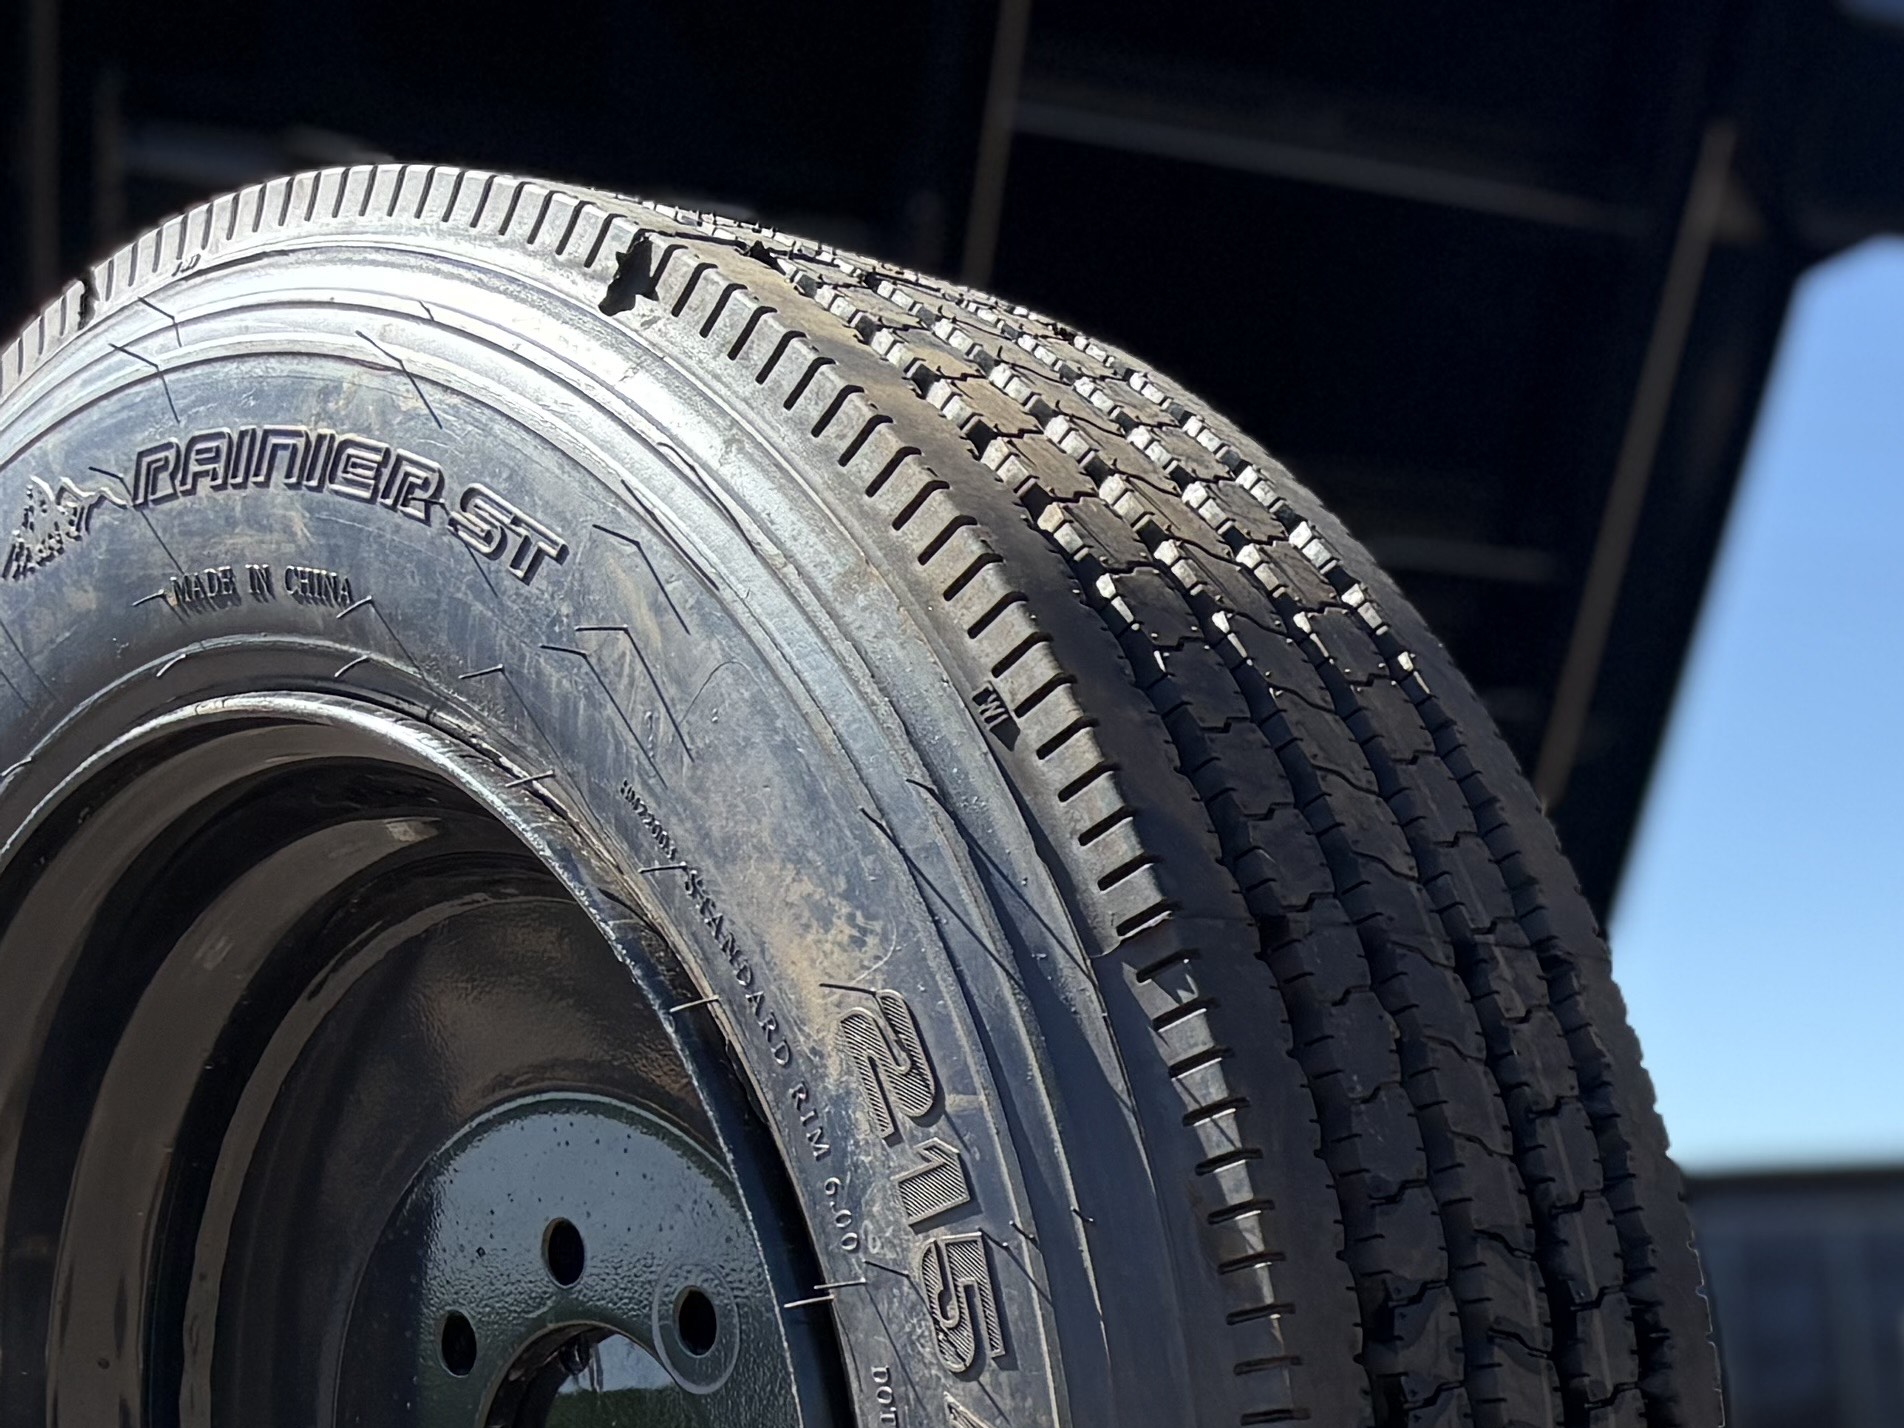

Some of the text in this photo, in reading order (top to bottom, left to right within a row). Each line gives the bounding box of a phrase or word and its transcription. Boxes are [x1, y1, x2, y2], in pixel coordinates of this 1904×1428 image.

[131, 424, 571, 587] RAINIER ST
[170, 563, 354, 604] MADE IN CHINA
[683, 868, 793, 1069] STANDARD
[789, 1080, 832, 1161] RIM
